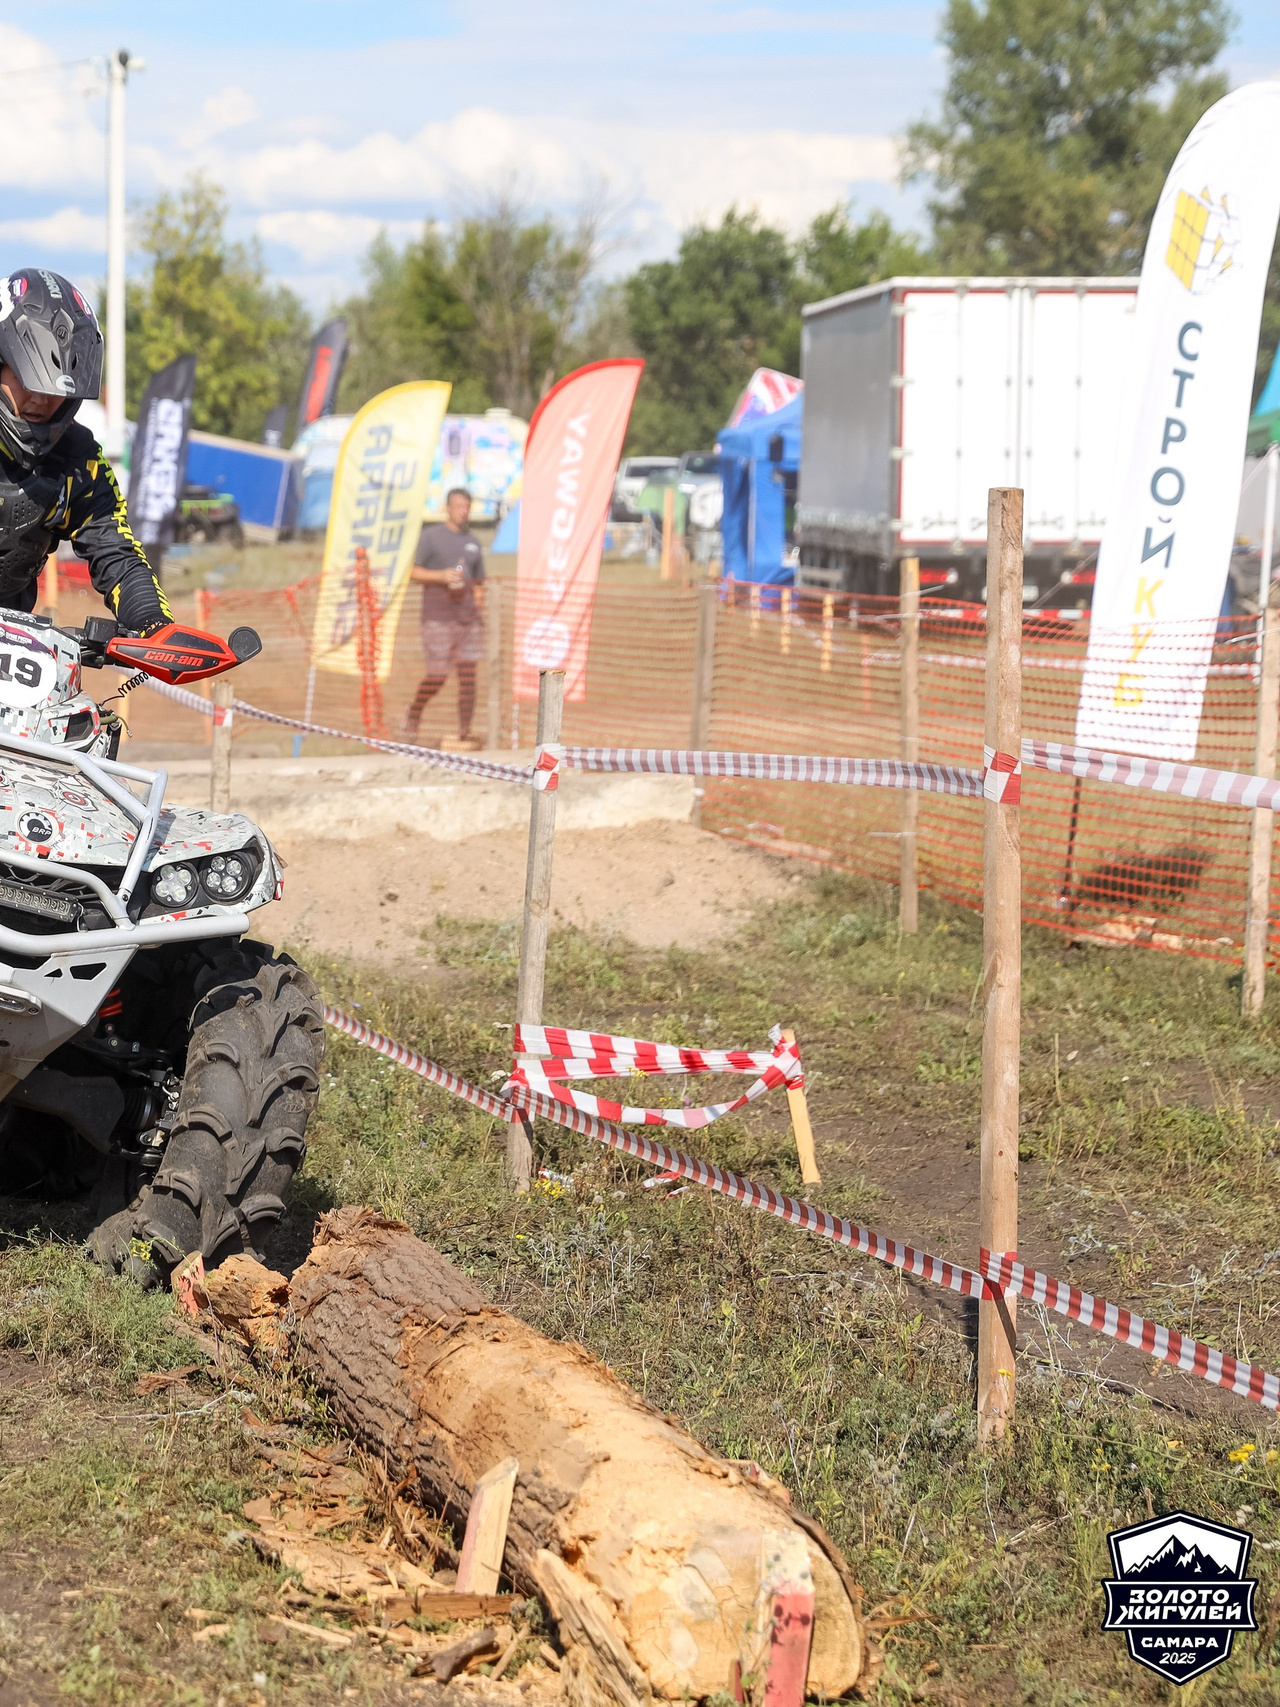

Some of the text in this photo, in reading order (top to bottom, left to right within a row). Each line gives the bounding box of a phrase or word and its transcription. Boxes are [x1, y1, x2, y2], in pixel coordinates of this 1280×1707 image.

[1112, 320, 1203, 709] СТРОЙ КУБ
[144, 651, 204, 667] can-am
[31, 826, 52, 836] BRP
